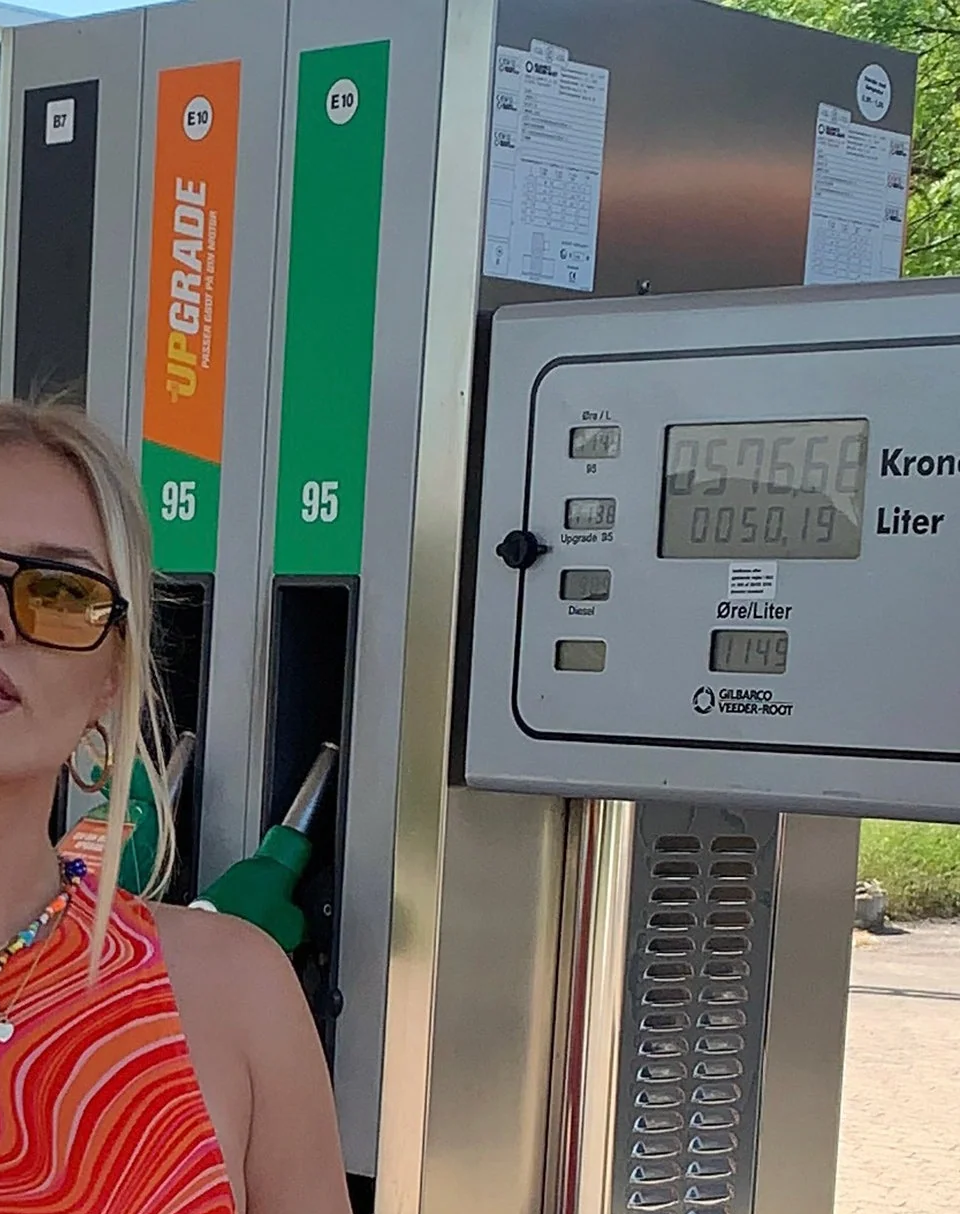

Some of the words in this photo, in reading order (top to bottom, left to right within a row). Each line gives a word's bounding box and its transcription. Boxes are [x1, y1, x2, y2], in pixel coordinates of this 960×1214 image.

[331, 93, 354, 111] E10
[53, 113, 67, 129] B7
[187, 109, 209, 126] E10
[166, 176, 207, 401] UPGRADE
[880, 447, 960, 477] Kron
[161, 481, 196, 521] 95
[301, 481, 338, 522] 95
[876, 506, 945, 535] Liter
[561, 533, 597, 545] Upgrade
[568, 605, 595, 616] Diesel
[716, 601, 793, 620] Øre/Liter
[718, 687, 773, 702] GILBARCO
[718, 702, 794, 716] VEEDER-ROOT
